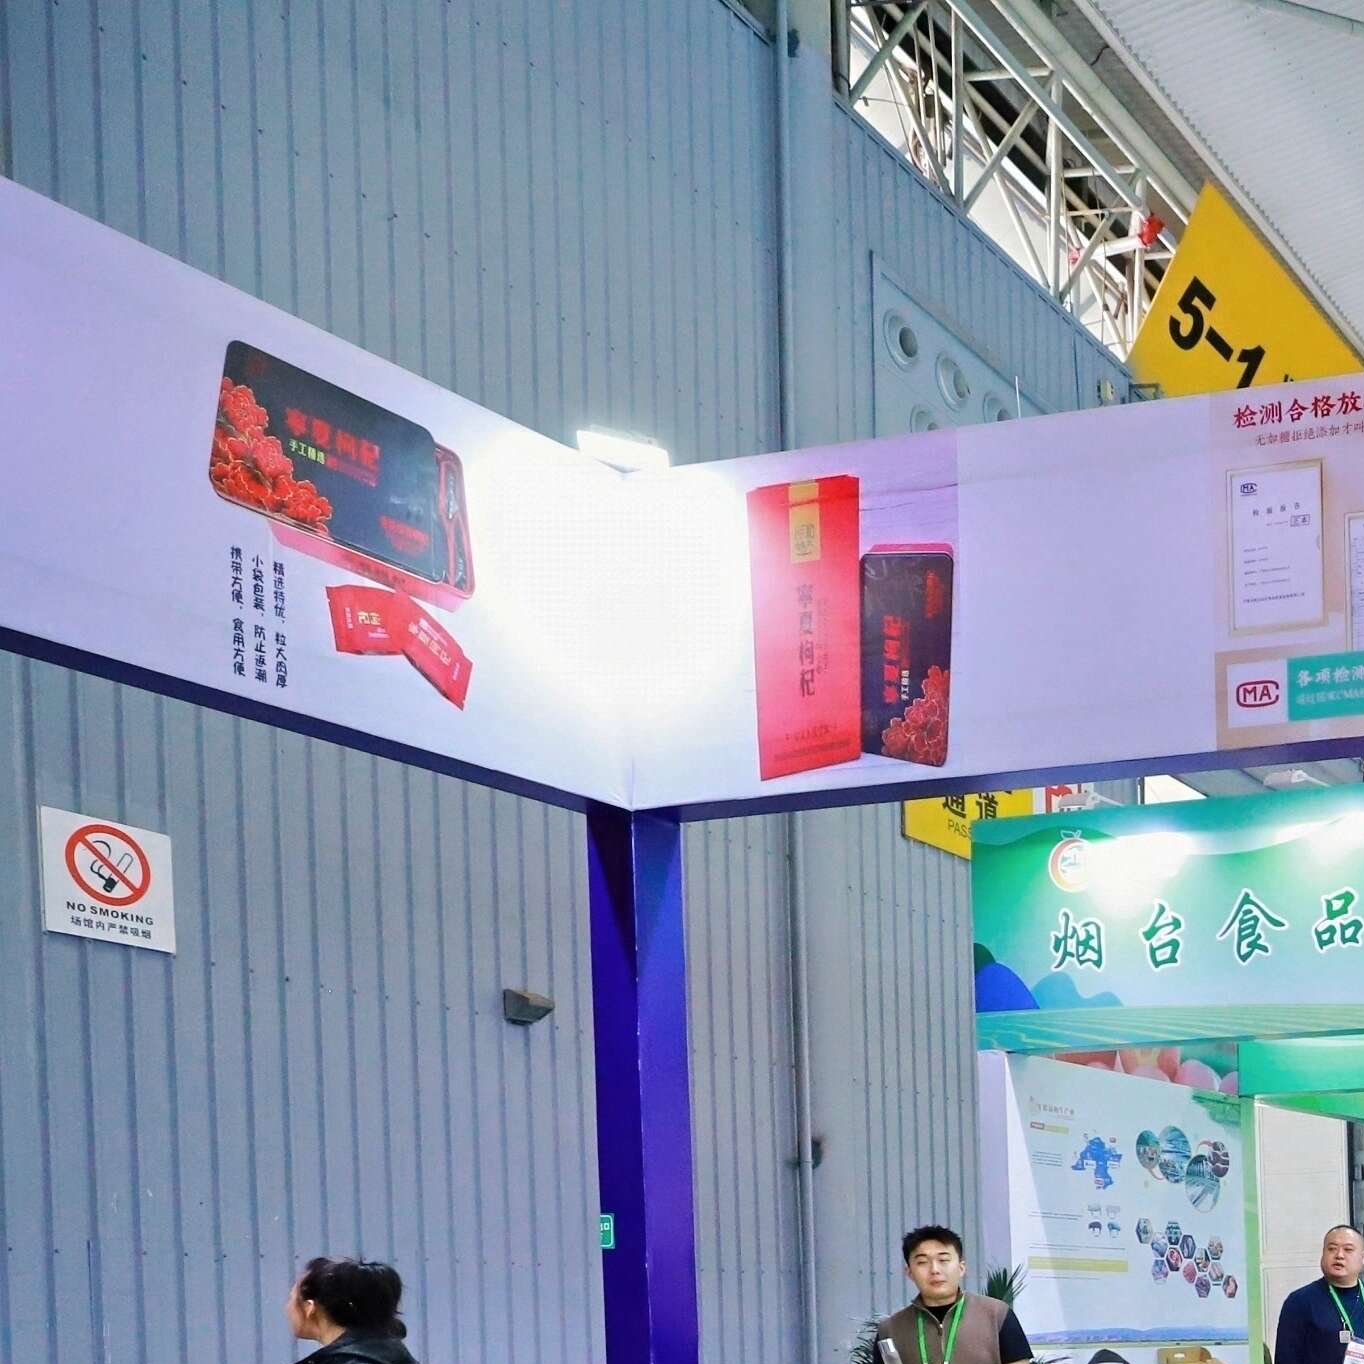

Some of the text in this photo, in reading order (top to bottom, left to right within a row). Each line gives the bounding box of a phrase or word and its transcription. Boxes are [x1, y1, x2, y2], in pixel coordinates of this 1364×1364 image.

[66, 901, 154, 925] NO SMOKING
[71, 915, 151, 939] 场馆内严禁吸烟
